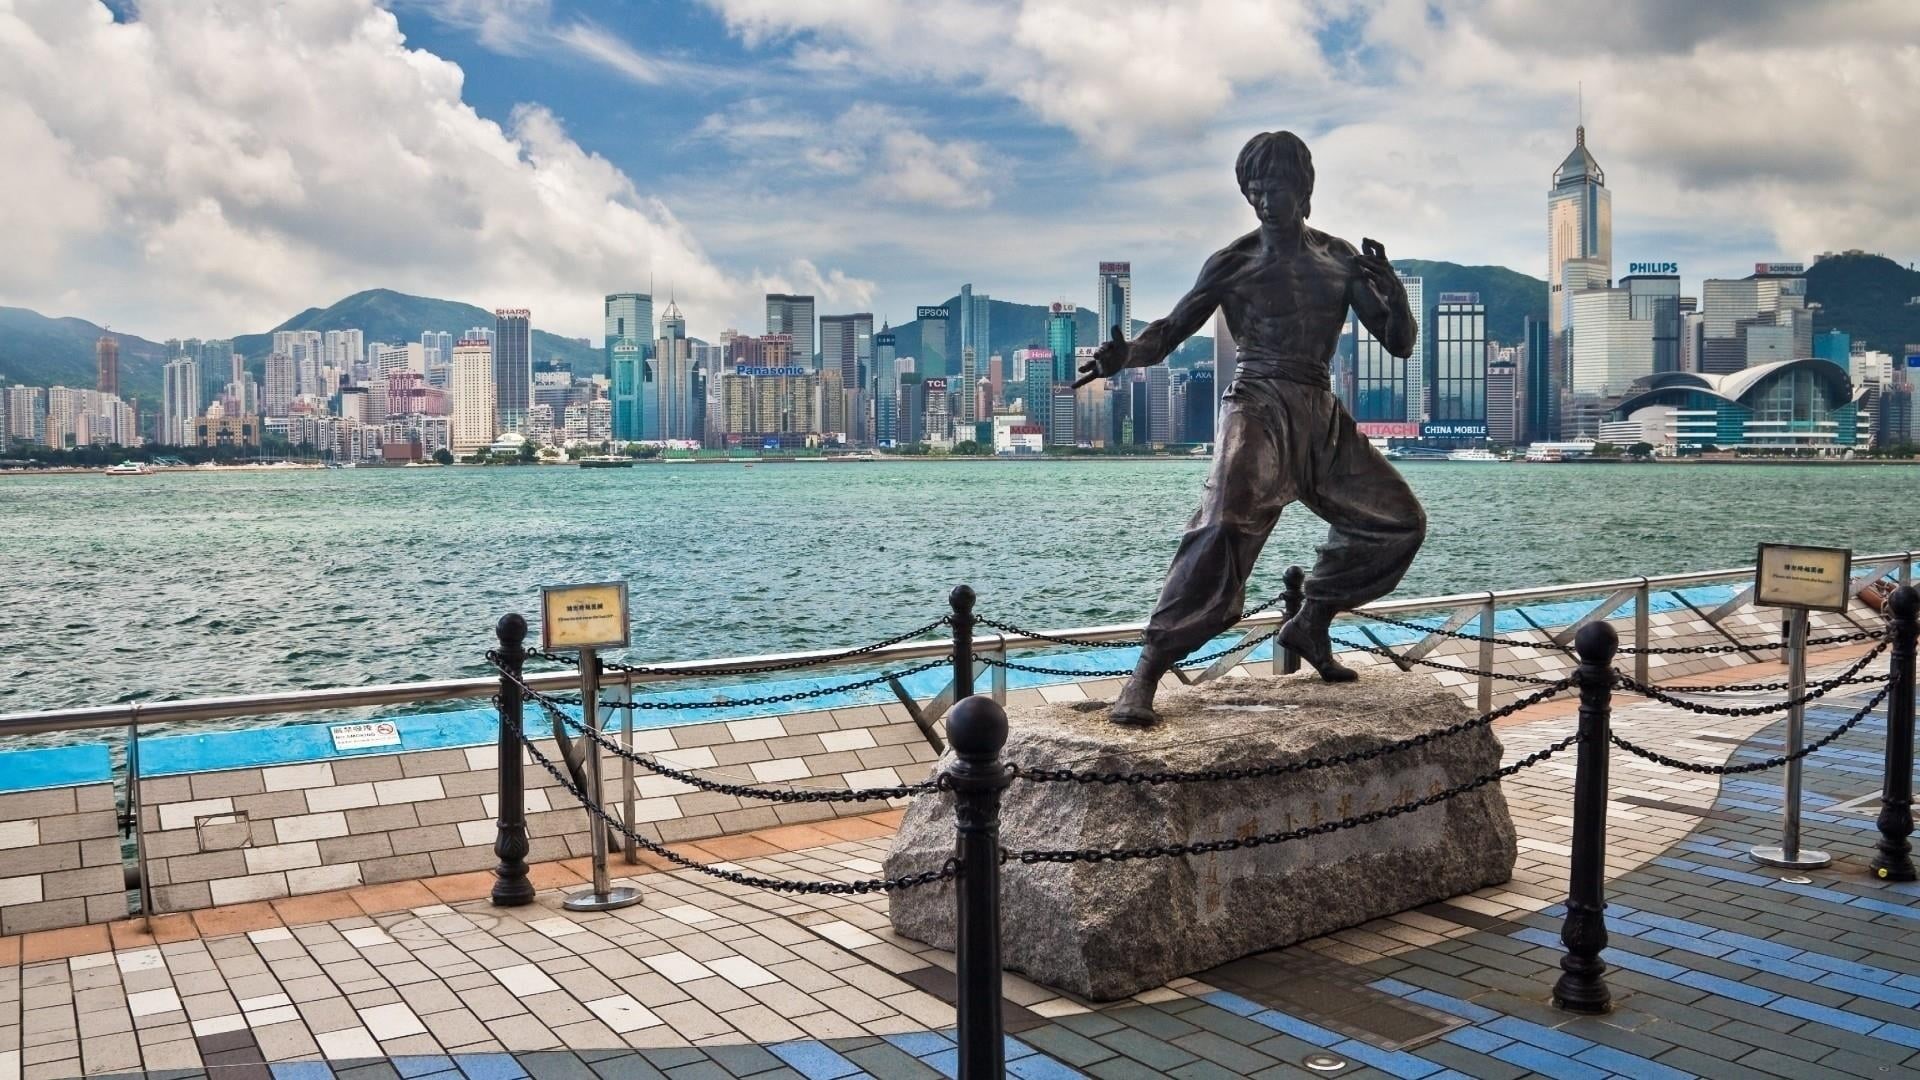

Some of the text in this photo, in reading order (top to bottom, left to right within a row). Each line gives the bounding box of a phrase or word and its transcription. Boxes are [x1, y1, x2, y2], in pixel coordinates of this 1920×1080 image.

[1630, 262, 1678, 273] PHILIPS
[919, 309, 949, 317] EPSON
[737, 365, 804, 375] Panasonic
[1011, 426, 1042, 434] MGM
[1360, 424, 1418, 435] HITACHI
[1425, 426, 1486, 434] CHINA MOBILE
